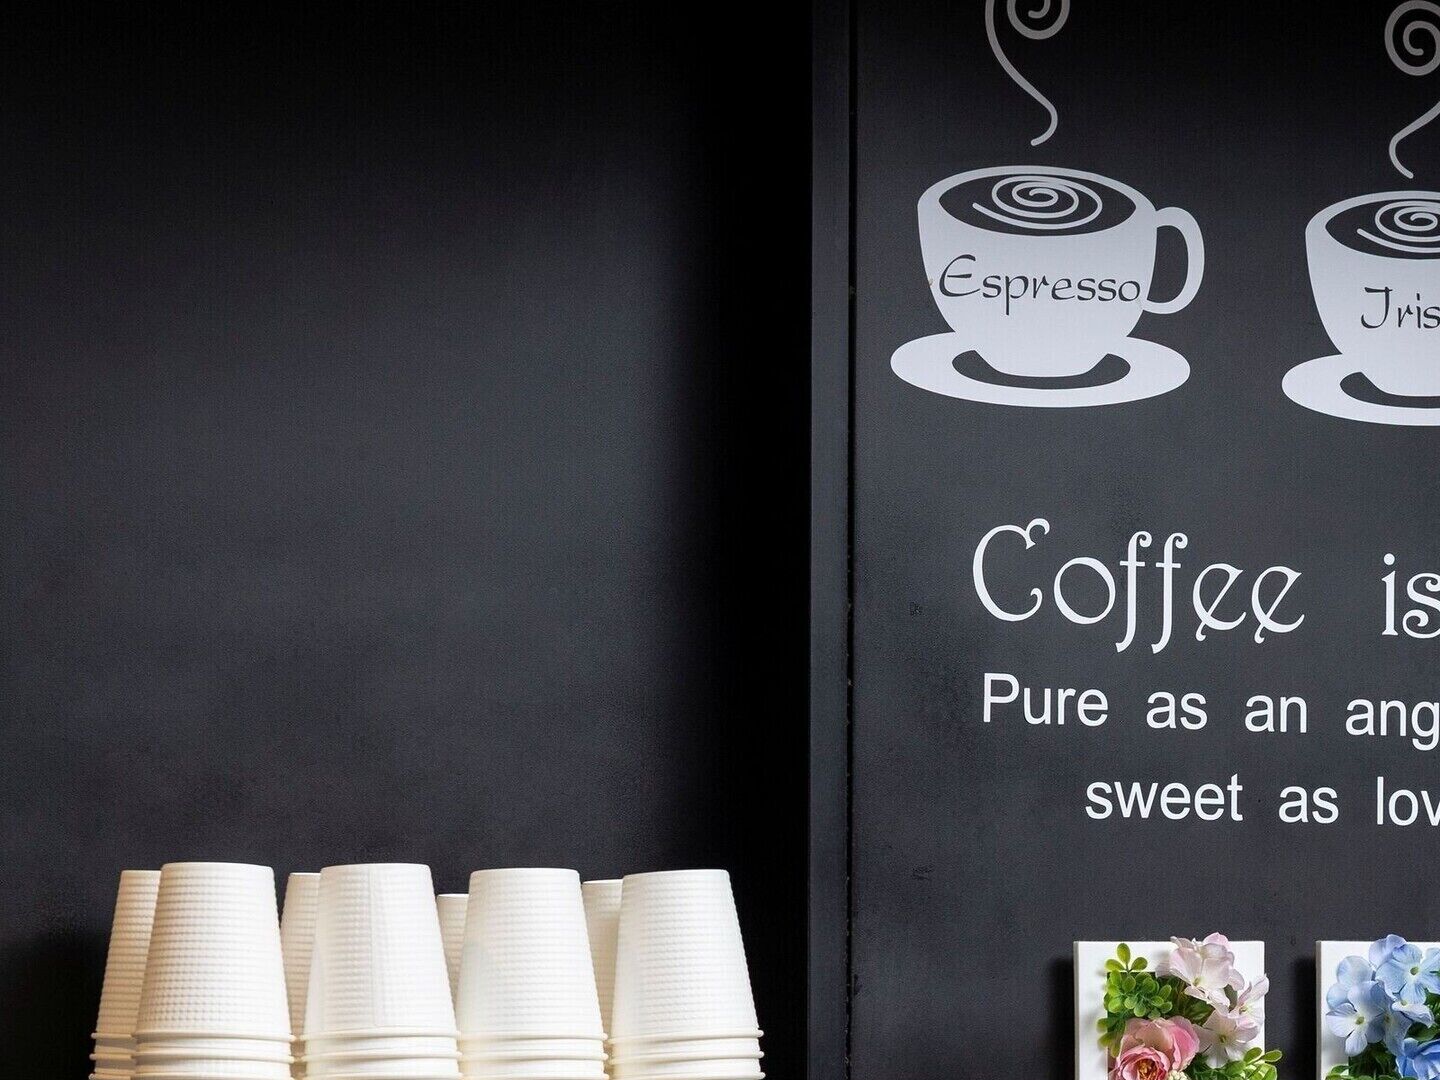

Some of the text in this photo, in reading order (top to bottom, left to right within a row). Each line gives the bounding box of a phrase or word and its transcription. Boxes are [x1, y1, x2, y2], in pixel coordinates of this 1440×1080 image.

[939, 254, 1142, 316] Espresso
[972, 518, 1306, 655] Coffee
[982, 673, 1109, 726] Pure
[1146, 692, 1208, 730] as
[1245, 693, 1308, 733] an
[1085, 773, 1243, 821] sweet
[1279, 786, 1339, 824] as
